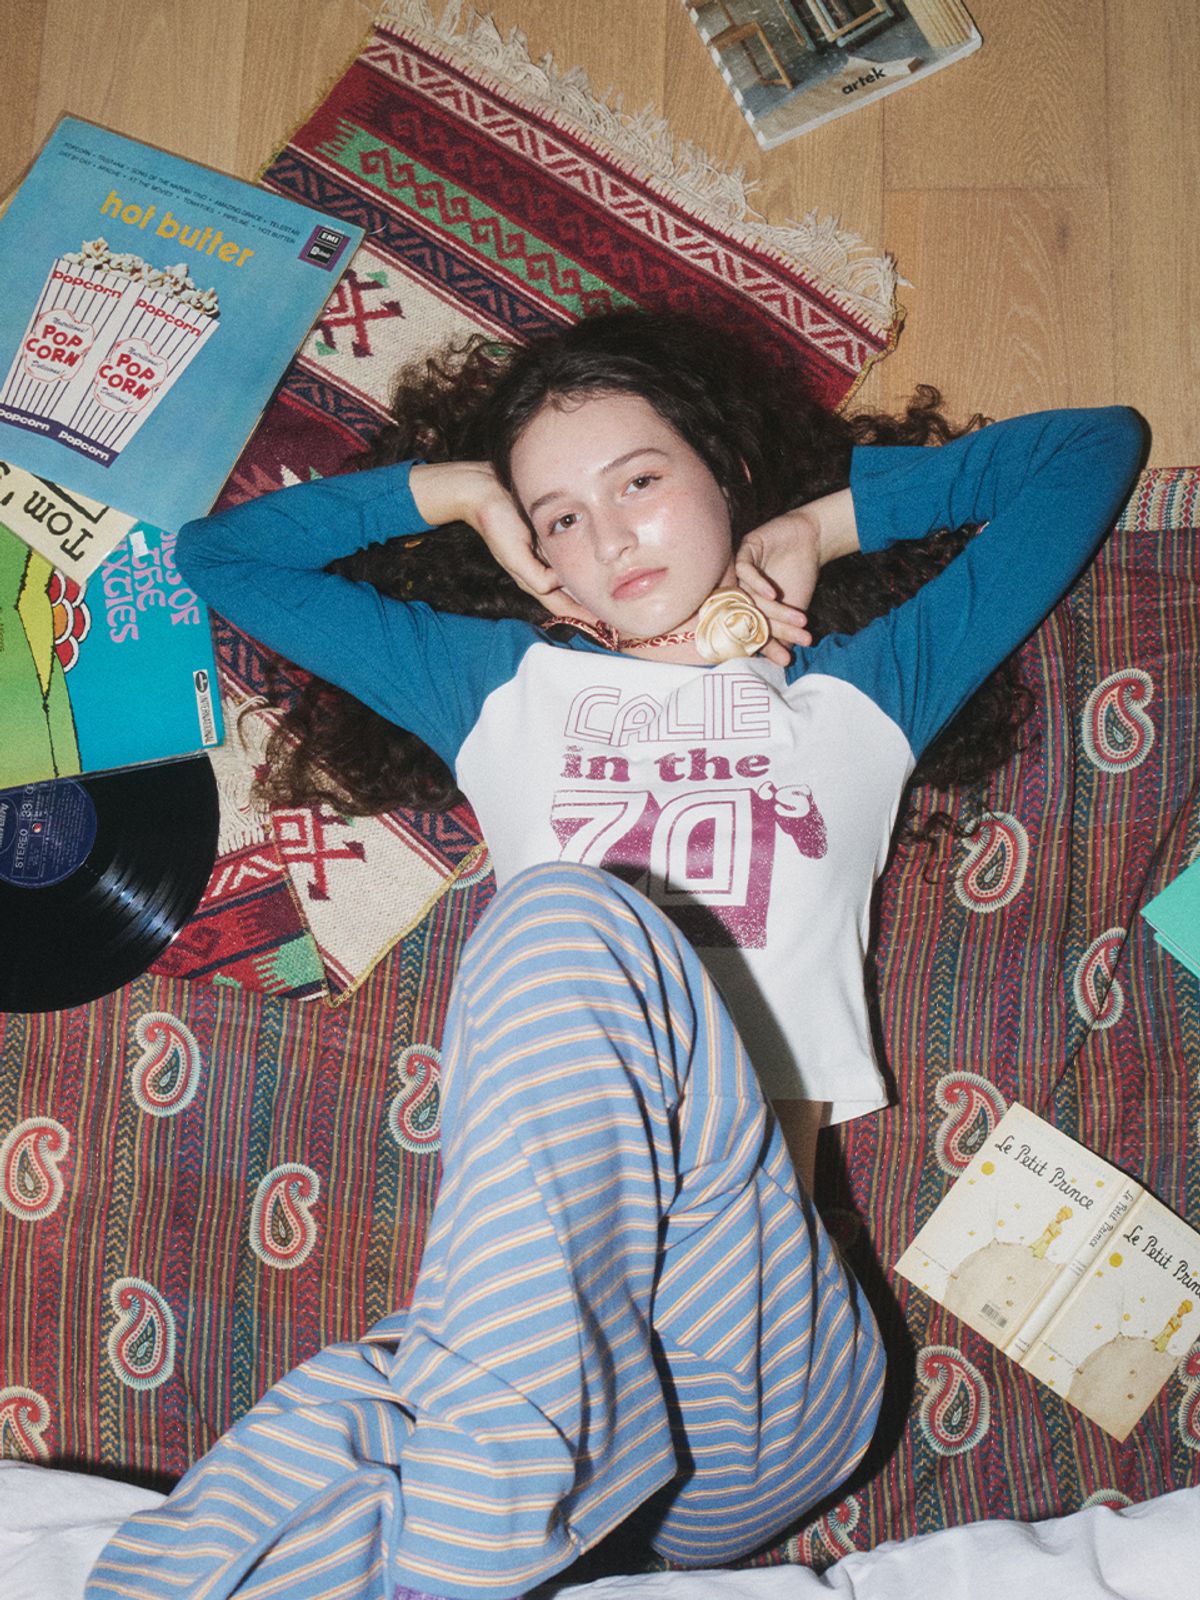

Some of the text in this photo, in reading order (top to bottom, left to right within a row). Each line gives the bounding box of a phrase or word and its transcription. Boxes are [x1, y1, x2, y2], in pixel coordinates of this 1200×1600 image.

[842, 67, 886, 95] artek
[101, 189, 255, 268] hot butter
[321, 232, 339, 244] EMI
[51, 270, 122, 300] popcorn
[135, 298, 202, 337] popcorn
[26, 338, 81, 367] CORN
[42, 325, 83, 347] POP
[99, 365, 151, 400] CORN
[117, 353, 155, 381] POP
[58, 430, 110, 461] popcorn
[101, 535, 139, 643] XTIES
[168, 588, 200, 625] OF
[560, 744, 771, 783] in the
[15, 828, 28, 869] STEREO
[550, 780, 828, 935] 70's
[994, 1135, 1094, 1210] Le Petit Prince
[1109, 1202, 1128, 1222] Petit
[1089, 1222, 1114, 1248] Prince
[1123, 1225, 1143, 1246] Le
[1141, 1235, 1173, 1270] Petit
